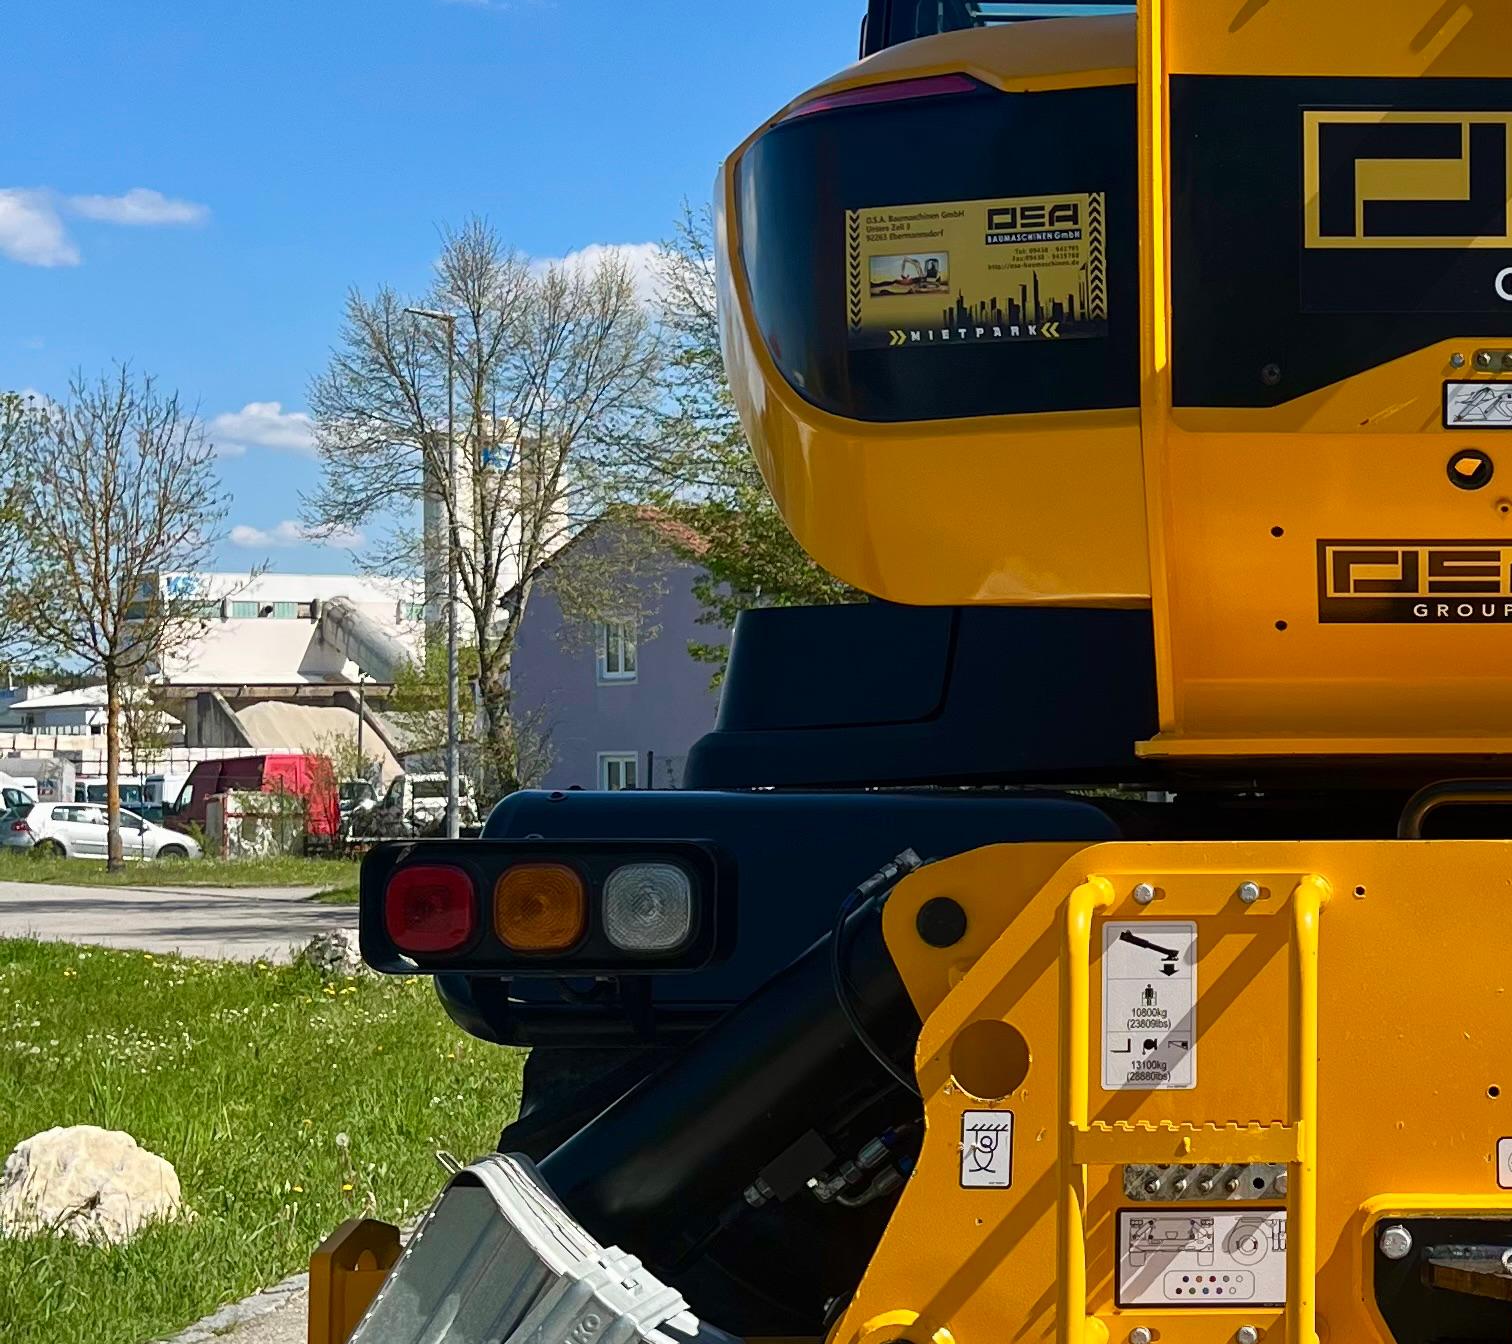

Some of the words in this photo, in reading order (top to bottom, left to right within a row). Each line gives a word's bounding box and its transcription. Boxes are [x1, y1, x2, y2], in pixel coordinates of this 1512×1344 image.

[987, 203, 1079, 230] OSA
[987, 232, 1052, 244] BAUMASCHINEN
[1053, 230, 1081, 241] GmbH
[910, 324, 1037, 342] MIETPARK
[1131, 1007, 1168, 1019] 10800kg
[1127, 1018, 1172, 1031] (23809lbs)
[1131, 1060, 1167, 1072] 13100kg
[1127, 1071, 1171, 1083] (28880lbs)
